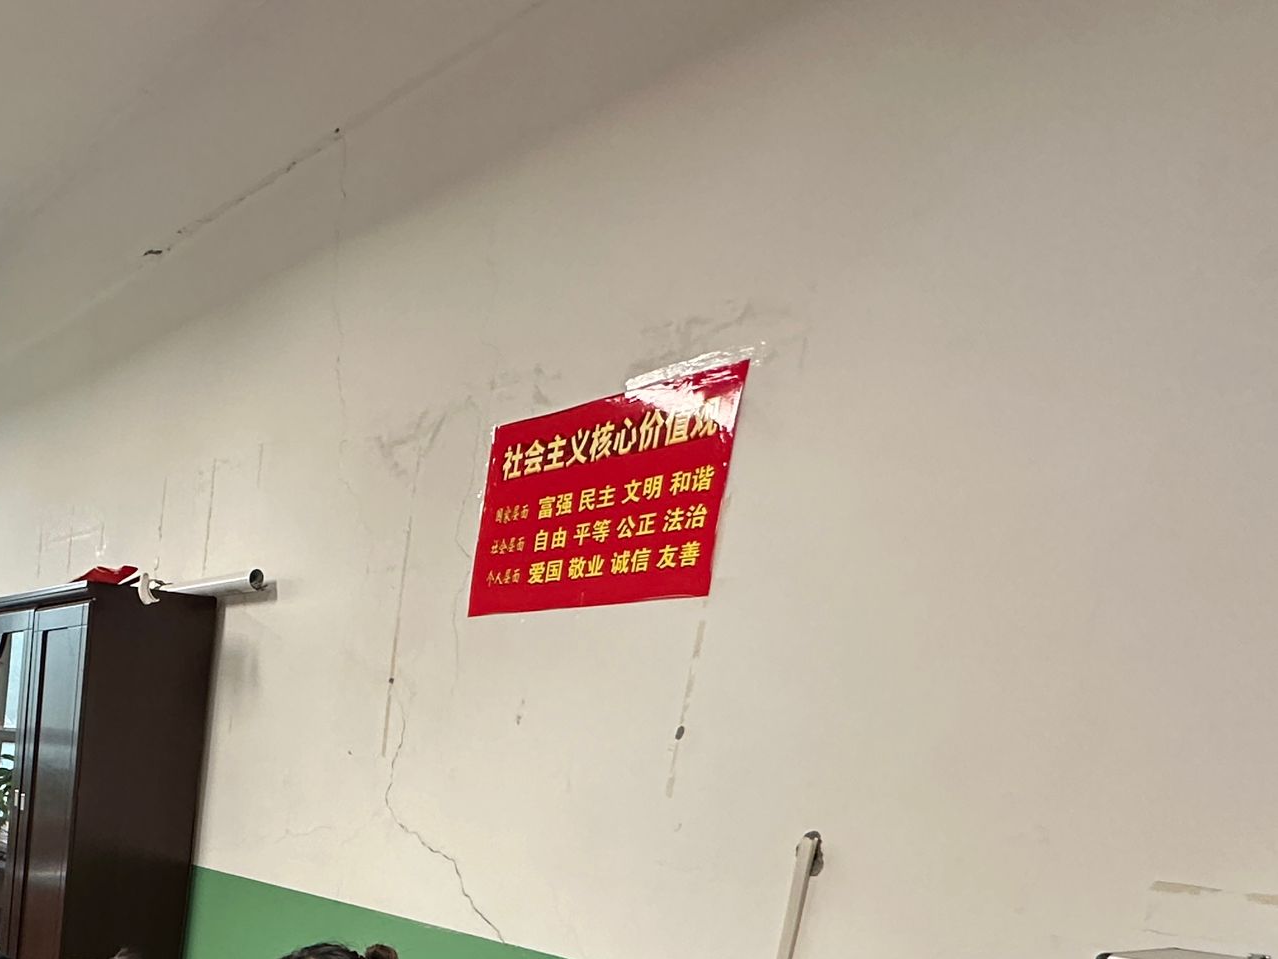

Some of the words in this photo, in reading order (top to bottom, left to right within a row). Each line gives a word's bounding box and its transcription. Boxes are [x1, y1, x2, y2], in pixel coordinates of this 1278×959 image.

[537, 492, 573, 520] 富强
[578, 485, 616, 513] 民主
[621, 475, 664, 504] 文明
[669, 464, 715, 496] 和谐
[533, 526, 567, 552] 自由
[573, 519, 611, 546] 平等
[617, 512, 657, 539] 公正
[662, 503, 708, 532] 法治
[528, 560, 563, 585] 爱国
[567, 554, 605, 580] 敬业
[611, 548, 651, 574] 诚信
[656, 541, 701, 569] 友善
